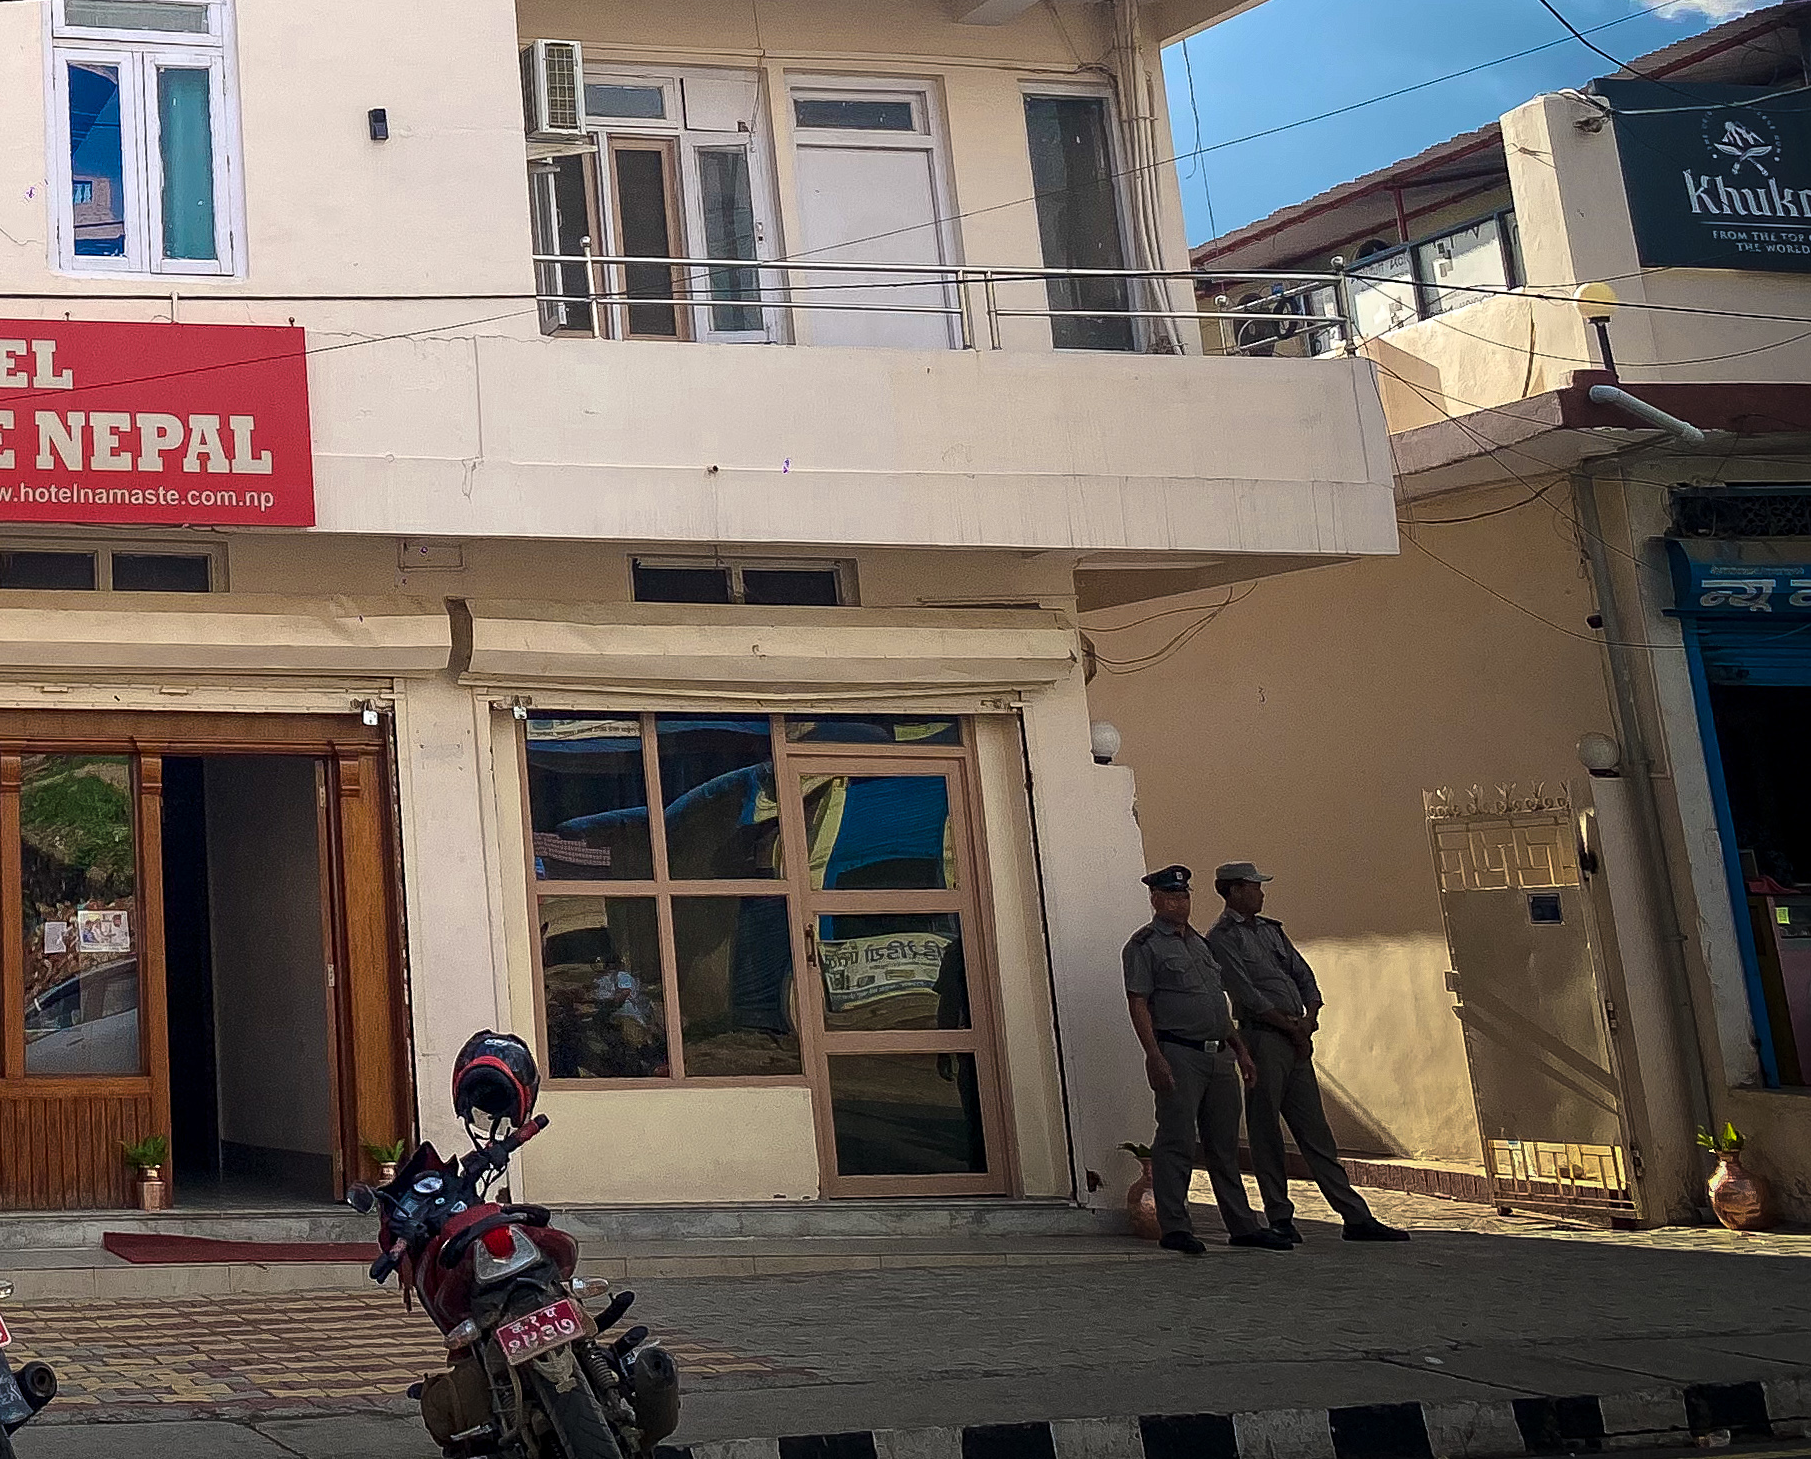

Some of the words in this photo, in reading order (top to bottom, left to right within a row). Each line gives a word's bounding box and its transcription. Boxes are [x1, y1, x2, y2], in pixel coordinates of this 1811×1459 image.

[1712, 230, 1747, 241] FROM
[1751, 232, 1777, 242] THE
[1780, 233, 1805, 242] TOP
[1736, 243, 1761, 253] THE
[1766, 244, 1811, 254] WORLD
[34, 410, 273, 475] NEPAL
